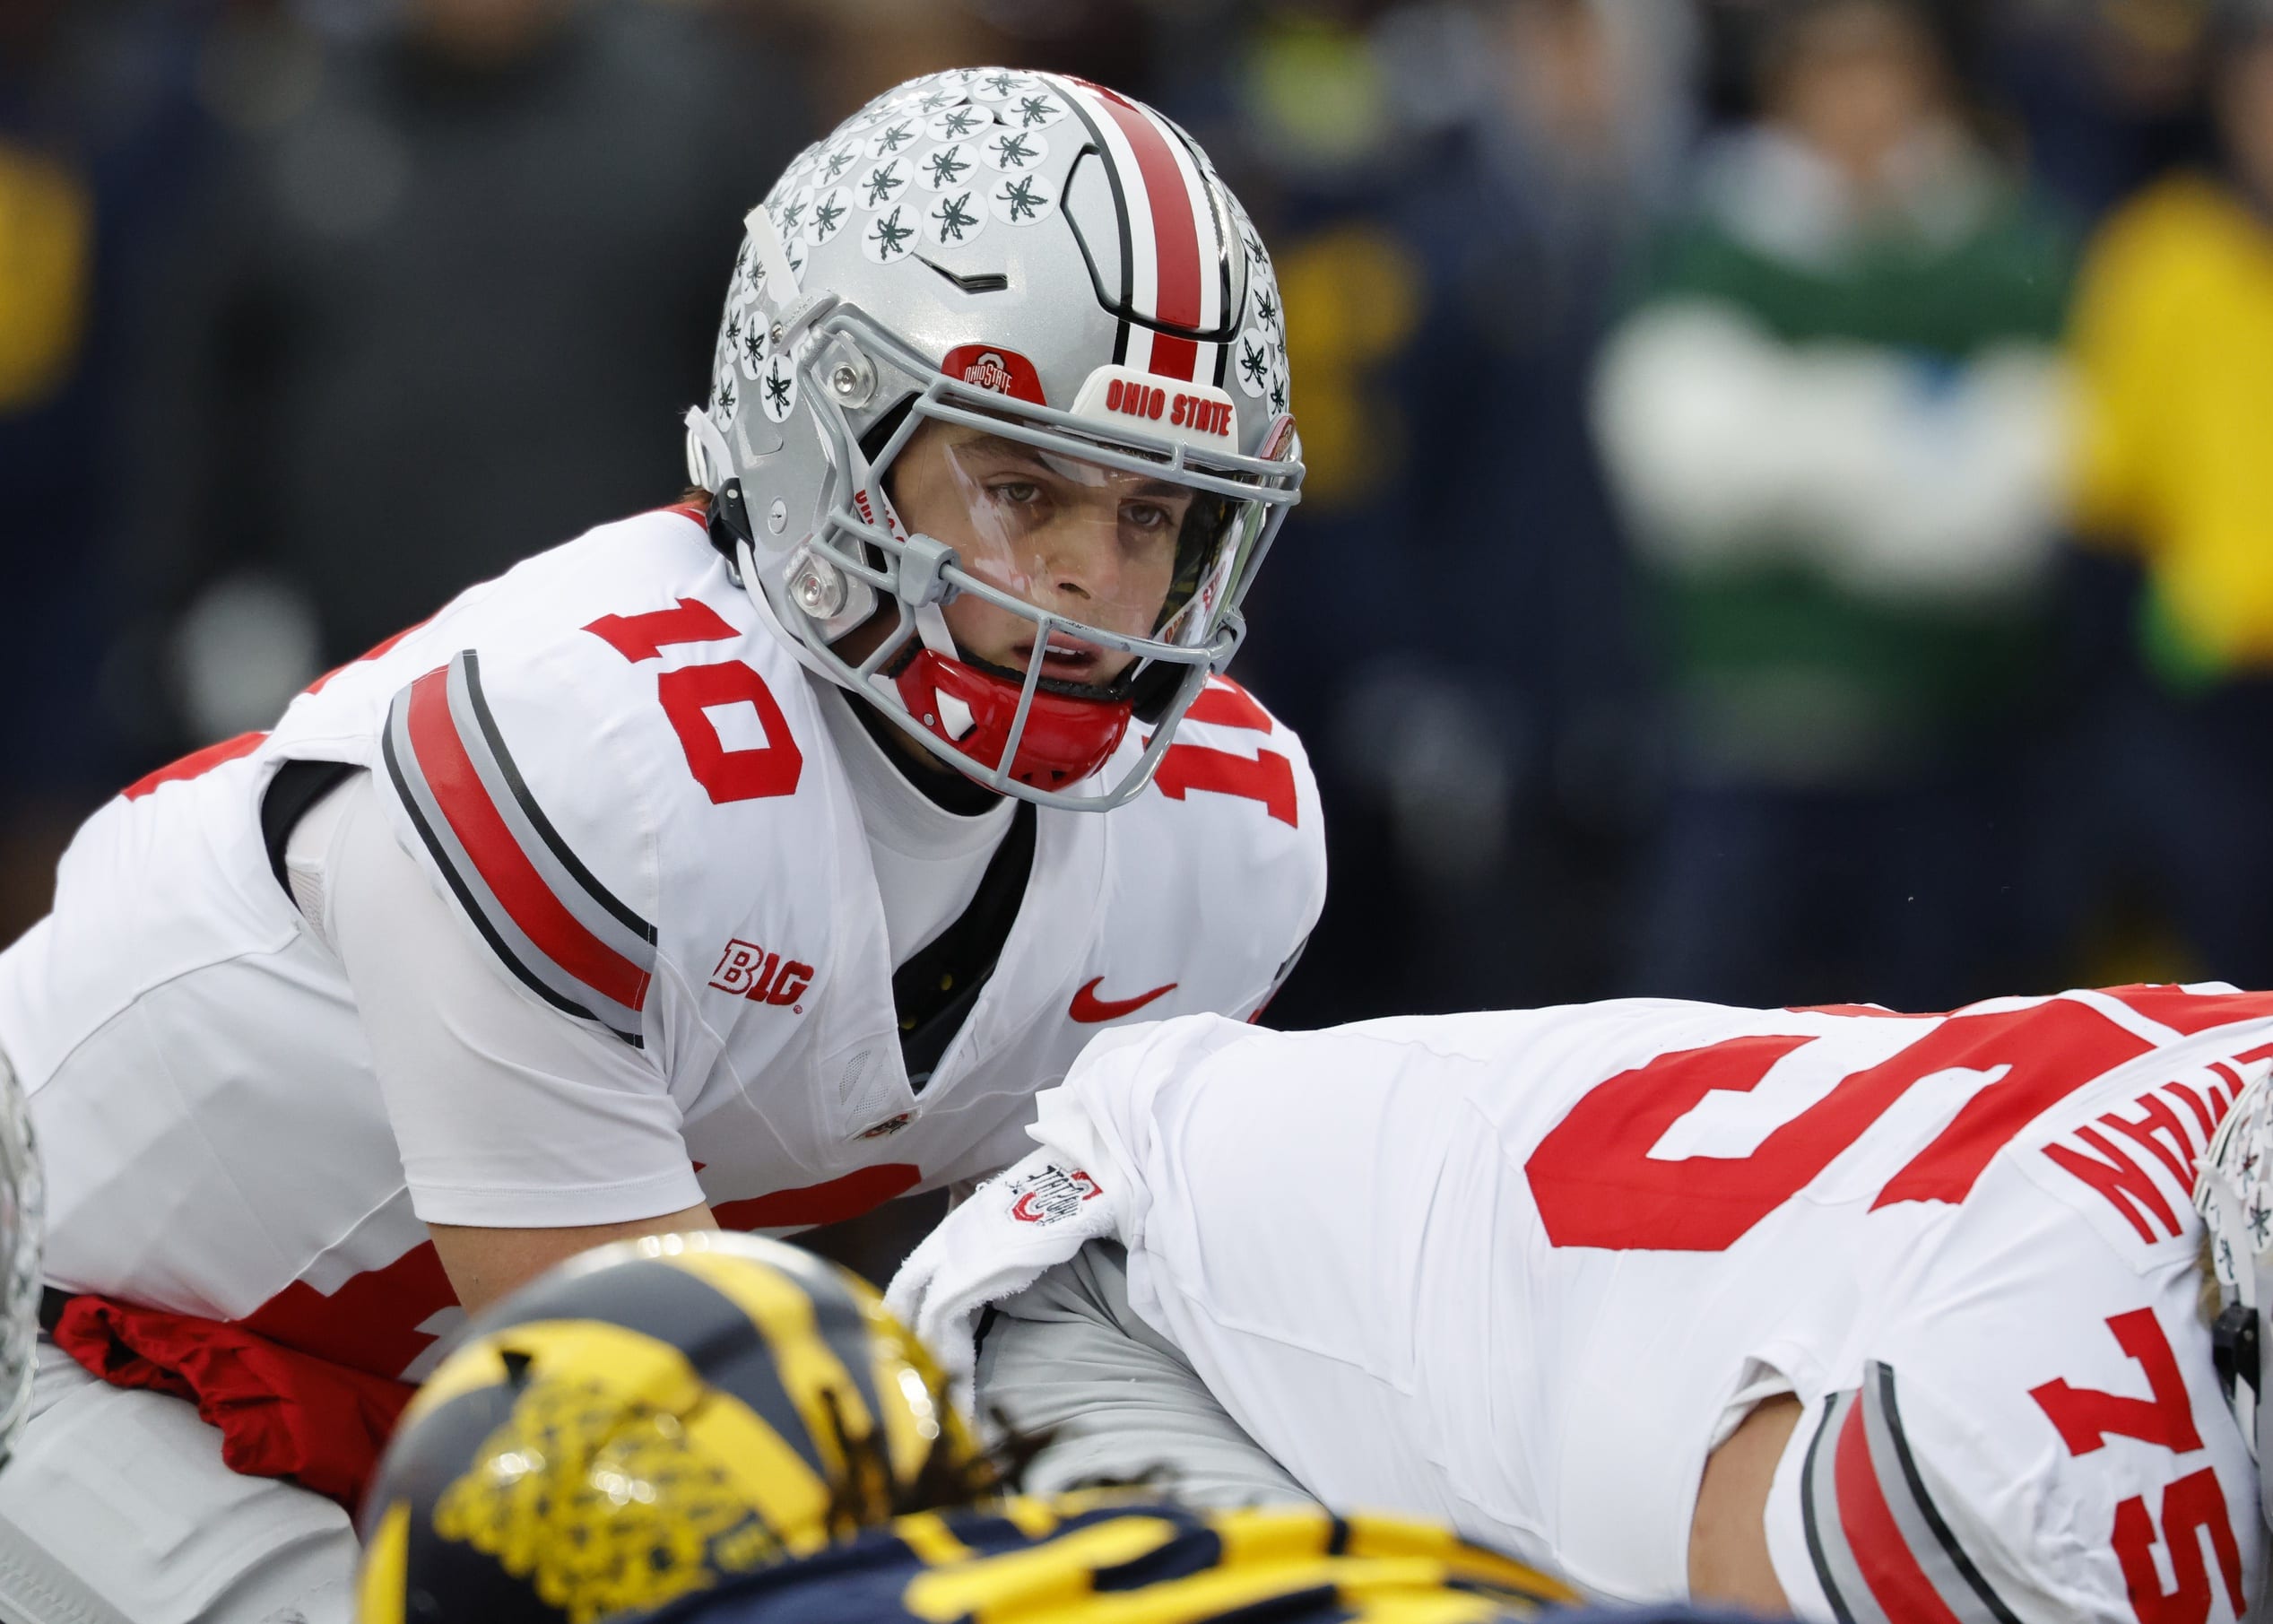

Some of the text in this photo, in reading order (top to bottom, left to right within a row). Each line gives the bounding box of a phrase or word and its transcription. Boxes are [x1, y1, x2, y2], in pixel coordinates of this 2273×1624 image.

[1106, 378, 1233, 437] OHIO STATE
[582, 597, 802, 805] 10
[2027, 1307, 2248, 1624] 75
